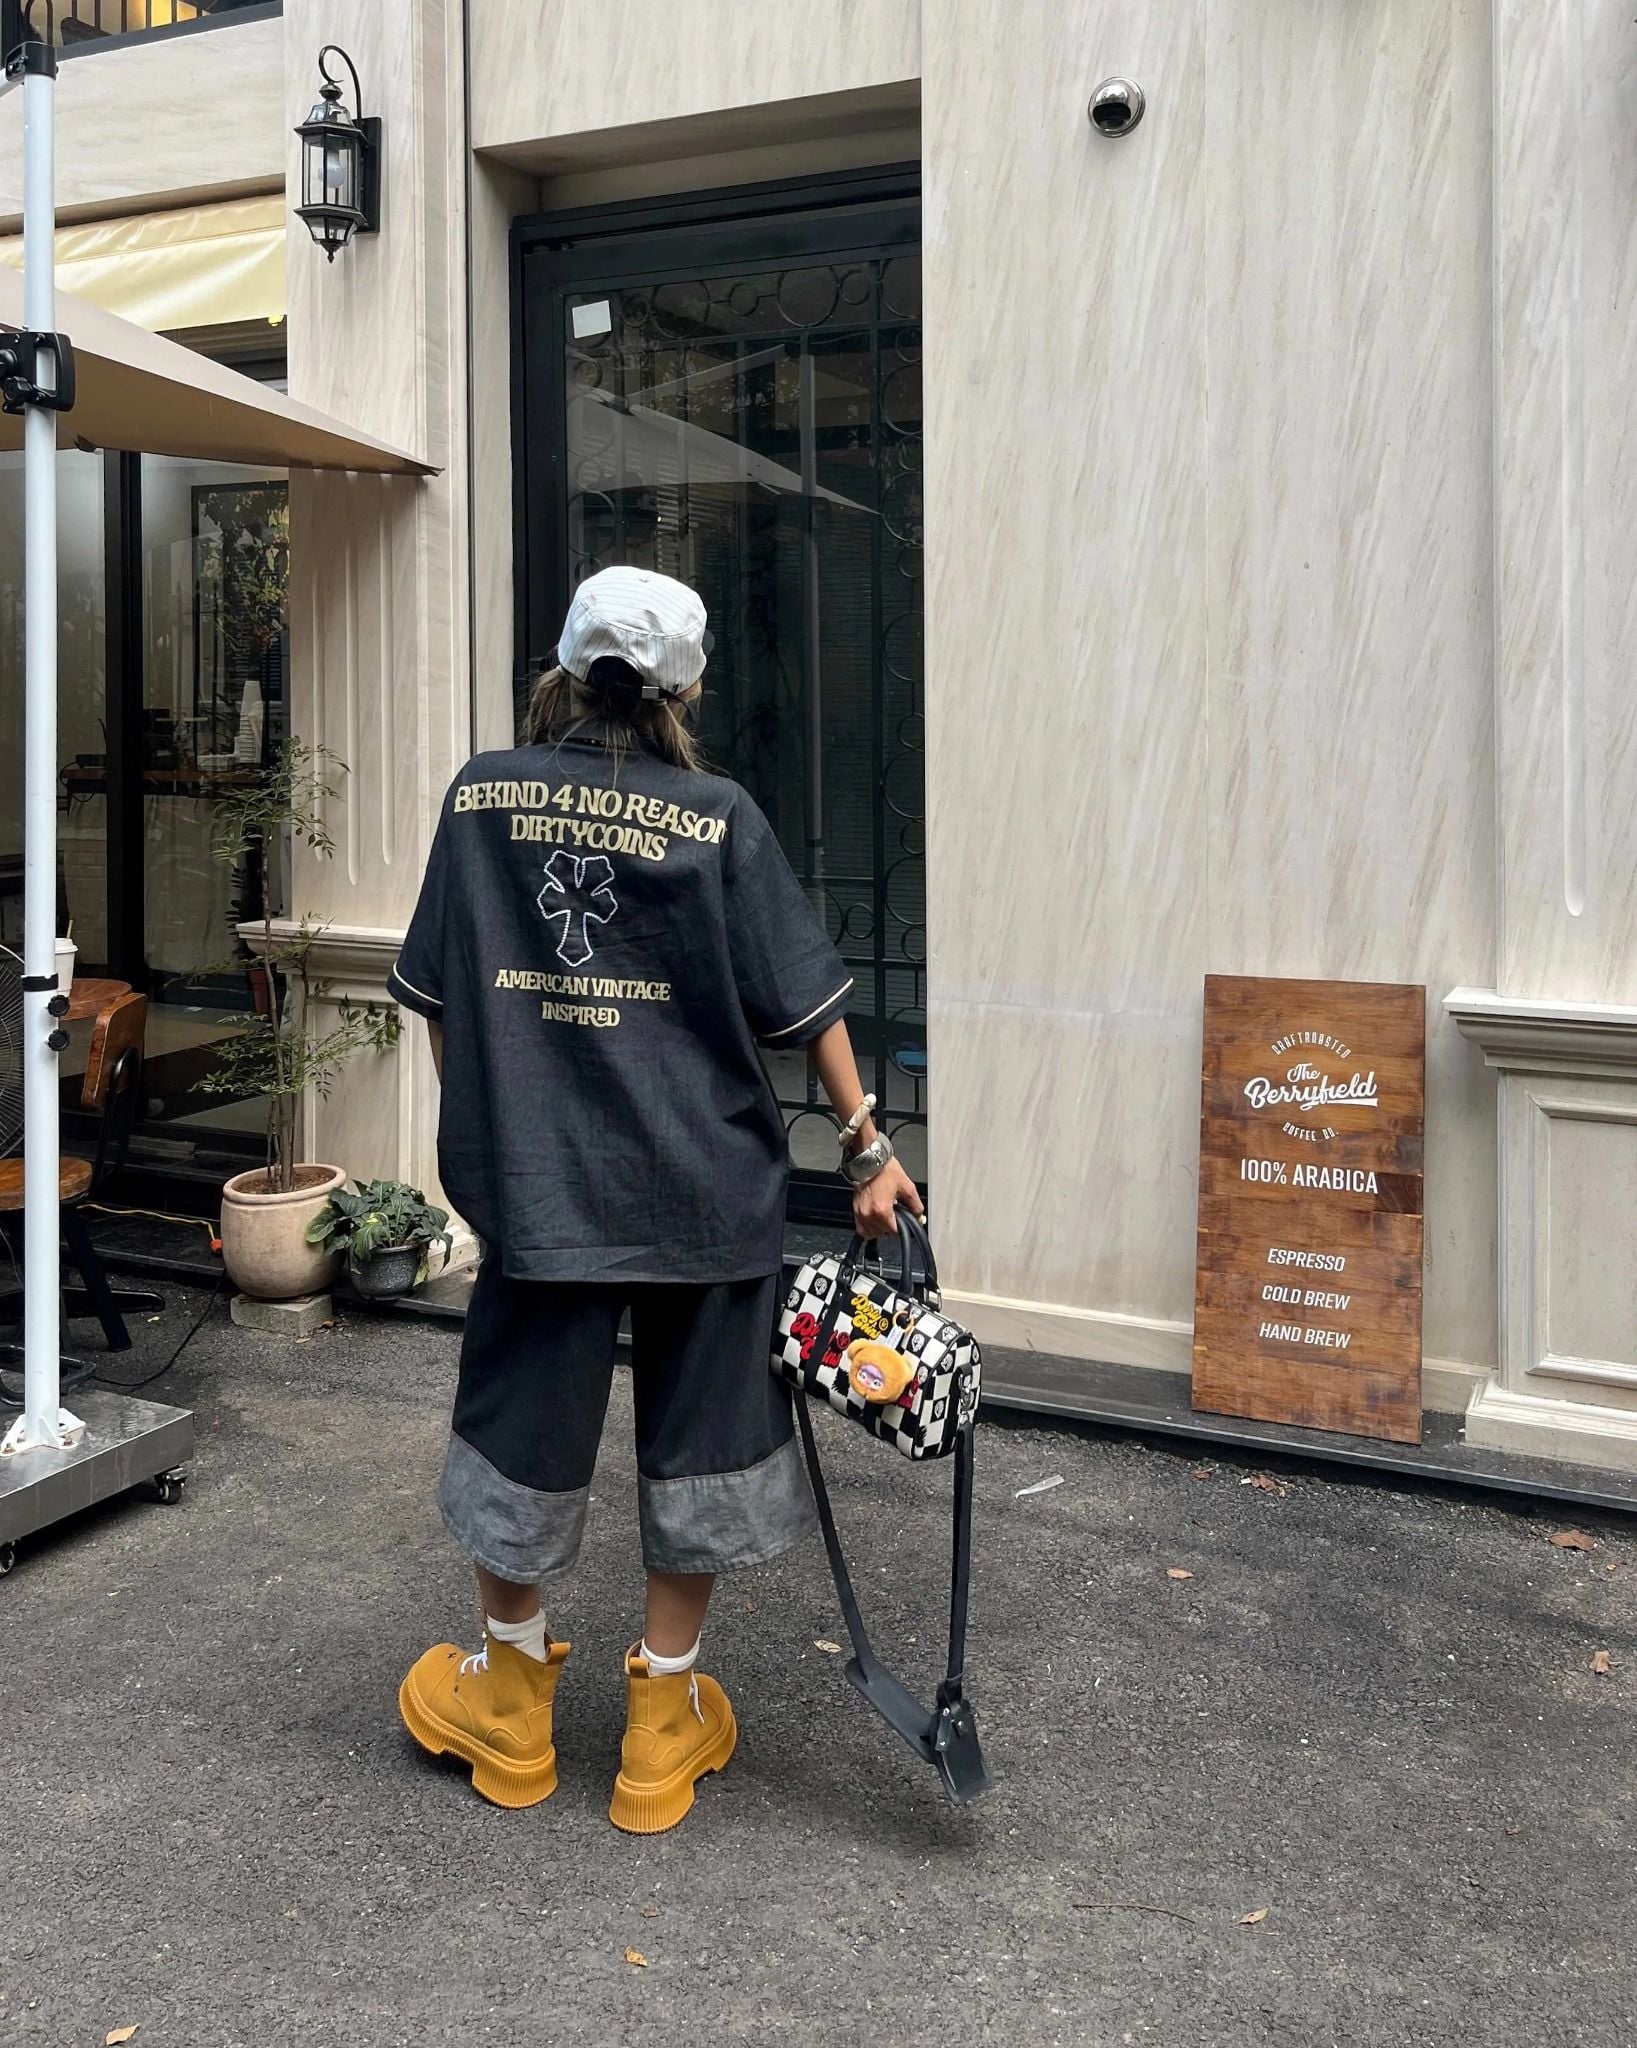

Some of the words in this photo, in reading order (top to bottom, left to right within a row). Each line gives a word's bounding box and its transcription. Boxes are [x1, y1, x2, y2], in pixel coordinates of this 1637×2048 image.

[454, 781, 549, 813] BEKIND
[551, 784, 574, 811] 4
[580, 786, 623, 818] NO
[511, 814, 669, 861] DIRTYCOINS
[494, 969, 589, 996] AMERICAN
[591, 977, 671, 1001] VINTAGE
[541, 1001, 621, 1027] INSPIRED
[1286, 1062, 1320, 1083] The
[1244, 1071, 1378, 1111] Berryfield
[1282, 1121, 1317, 1142] COFFEE
[1240, 1158, 1287, 1185] 100%
[1292, 1164, 1378, 1194] ARABICA
[1267, 1248, 1346, 1272] ESPRESSO
[1261, 1285, 1301, 1304] COLD
[1303, 1290, 1350, 1310] BREW
[1259, 1322, 1302, 1342] HAND
[1304, 1327, 1351, 1348] BREW
